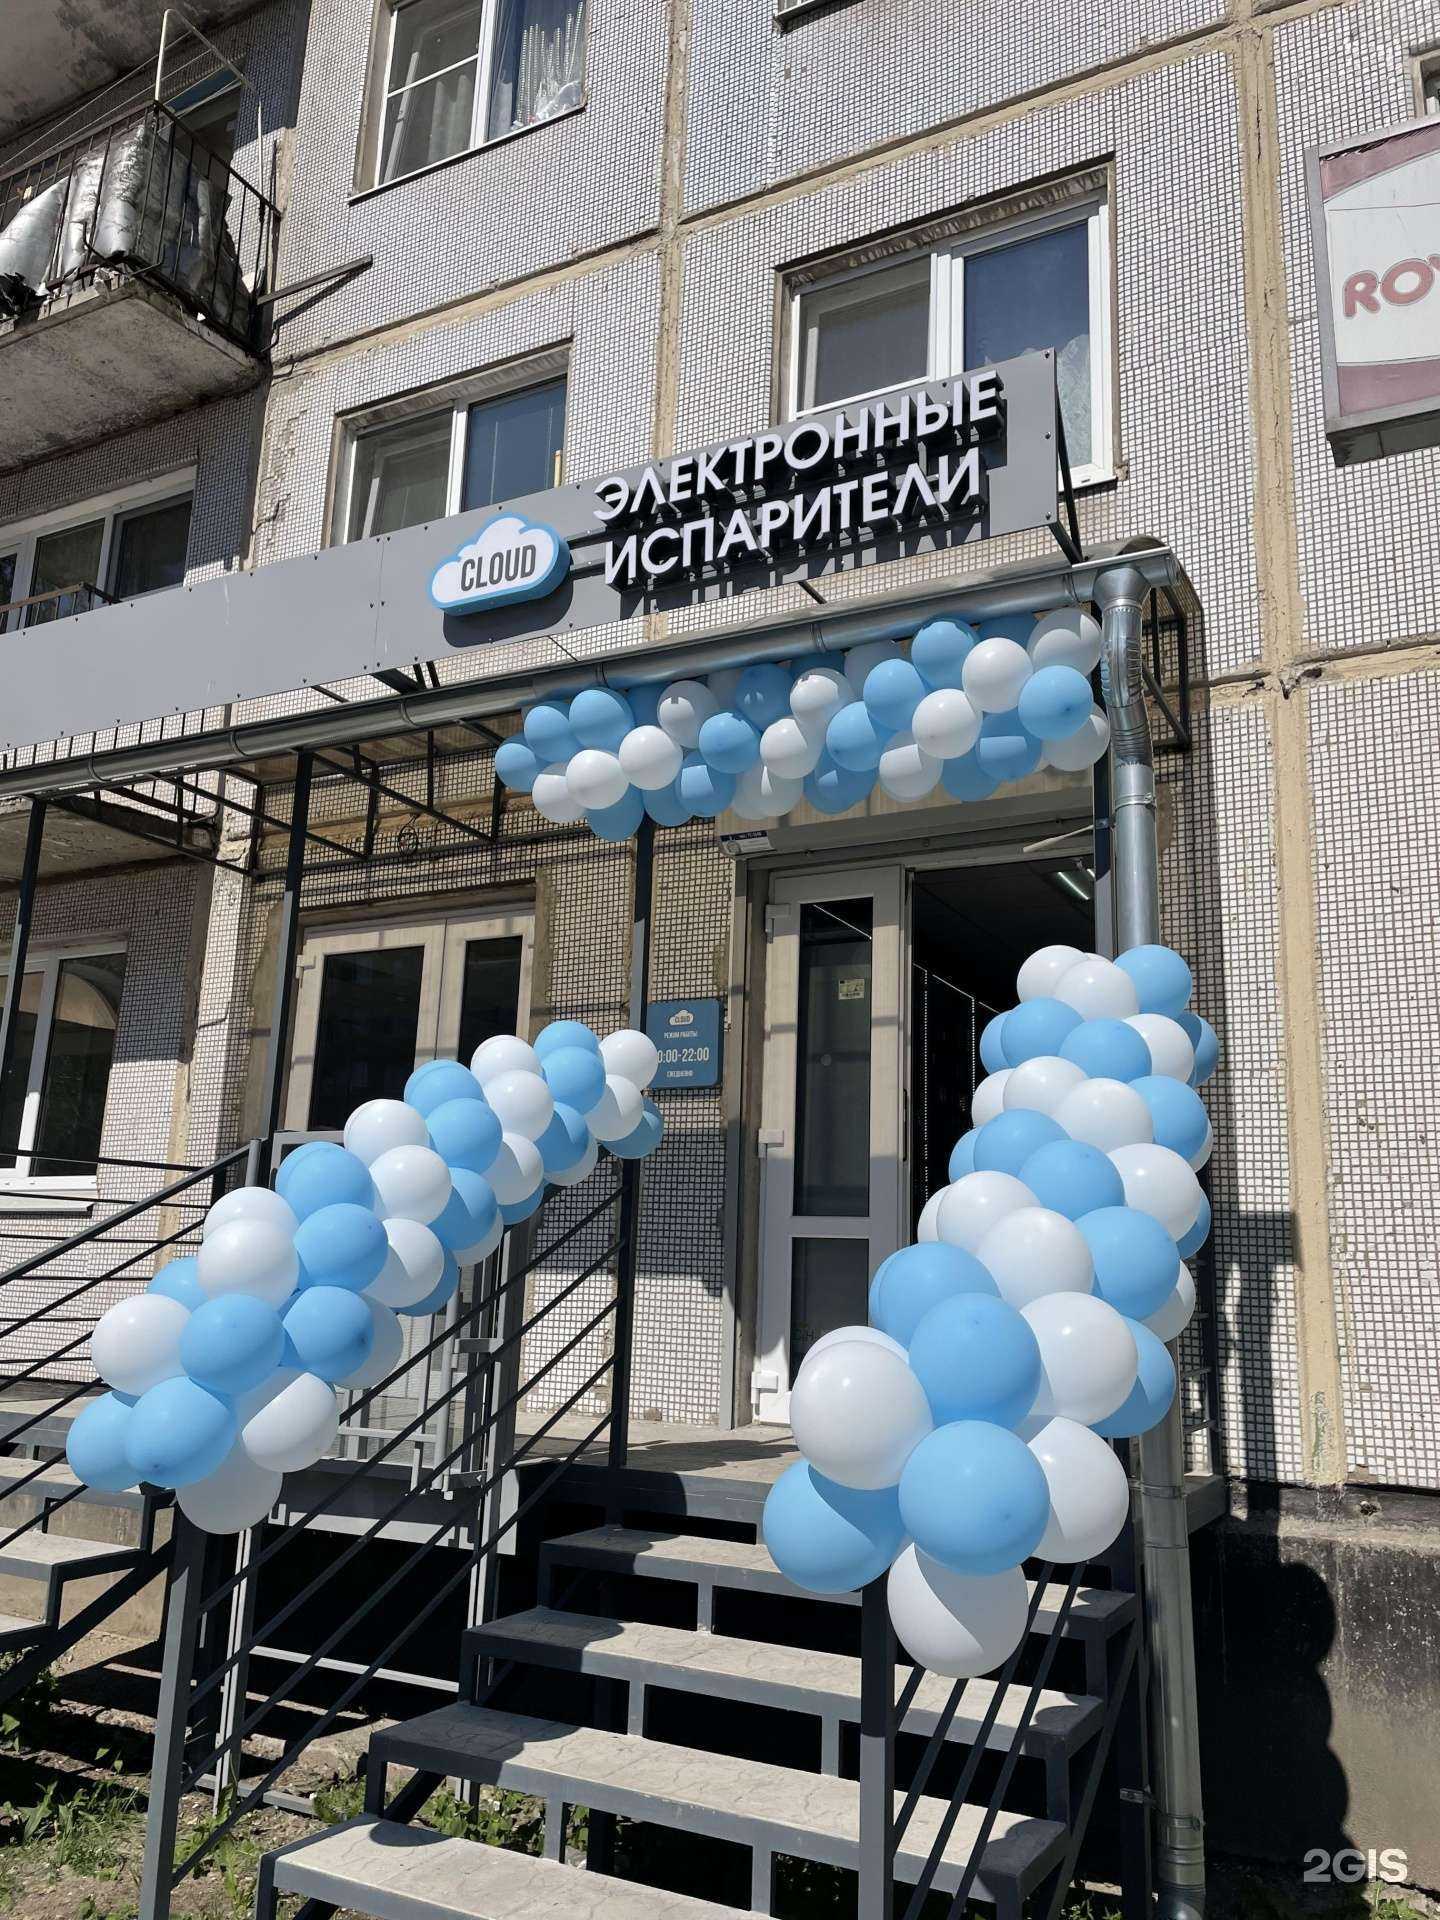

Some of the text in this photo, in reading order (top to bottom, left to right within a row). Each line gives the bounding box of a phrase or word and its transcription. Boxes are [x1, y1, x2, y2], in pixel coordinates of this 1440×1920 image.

[1343, 254, 1440, 317] RO
[594, 371, 1000, 521] ЭЛЕКТРОННЫЕ
[605, 448, 980, 585] ИСПАРИТЕЛИ
[461, 544, 536, 591] CLOUD
[657, 1047, 710, 1063] 0:00-22:00
